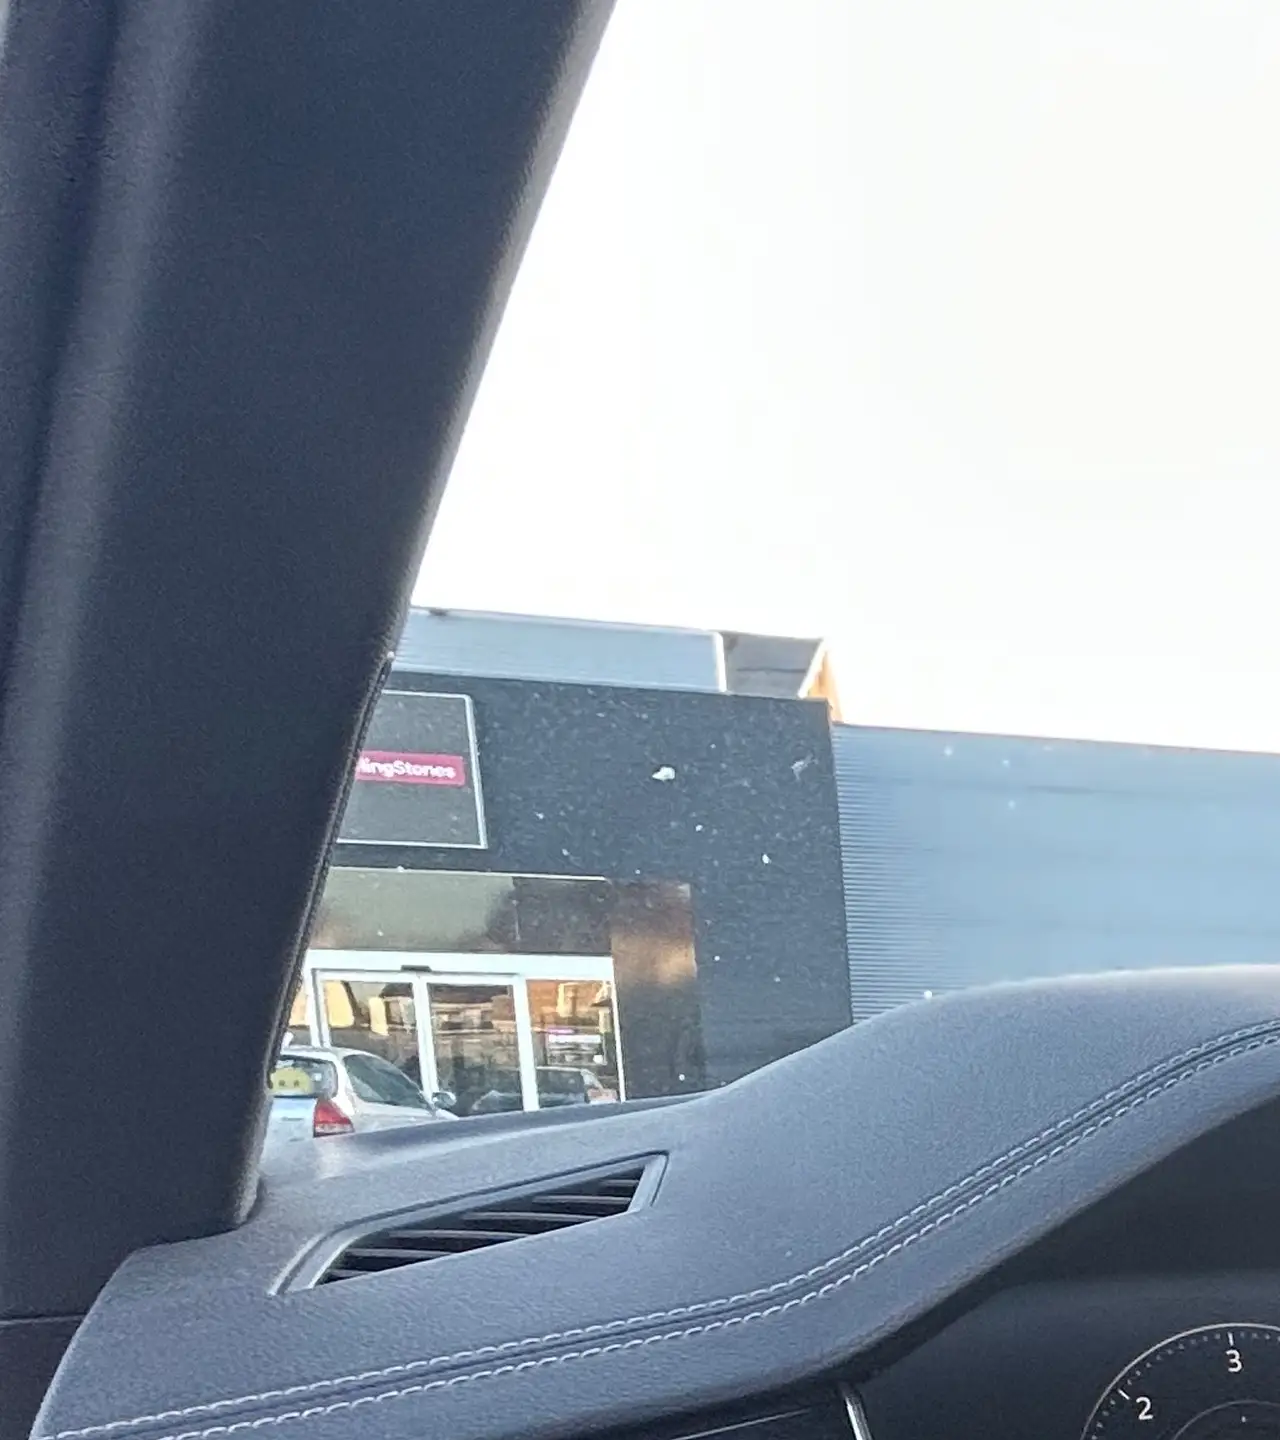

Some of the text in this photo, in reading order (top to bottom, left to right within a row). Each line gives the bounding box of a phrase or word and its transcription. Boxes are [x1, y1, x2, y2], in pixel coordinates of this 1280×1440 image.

[356, 757, 457, 779] lingStones
[1227, 1350, 1243, 1373] 3
[1136, 1397, 1154, 1421] 2
